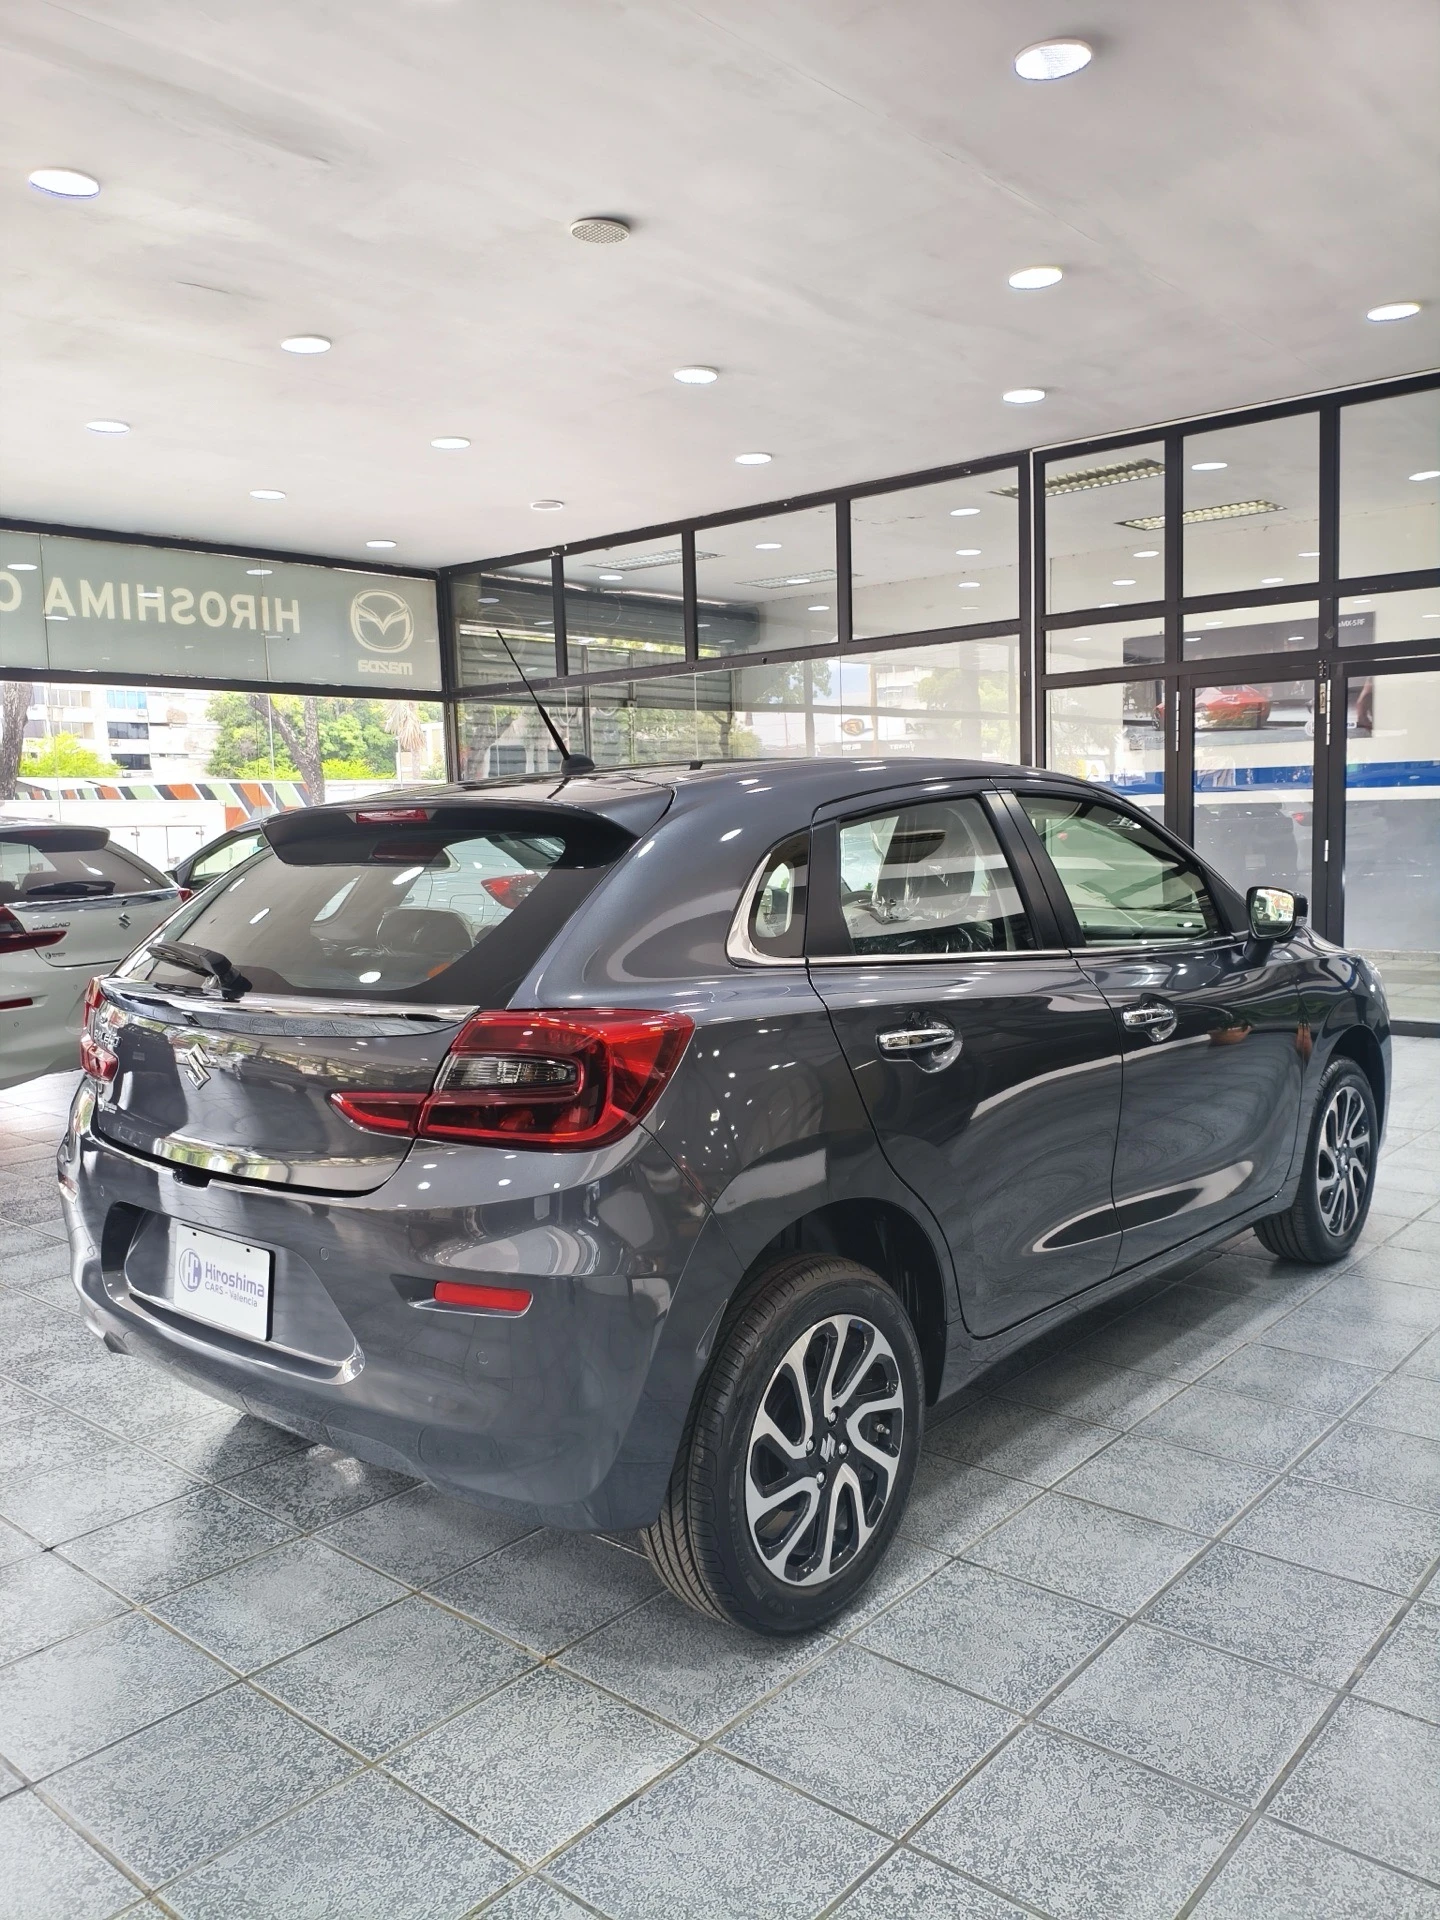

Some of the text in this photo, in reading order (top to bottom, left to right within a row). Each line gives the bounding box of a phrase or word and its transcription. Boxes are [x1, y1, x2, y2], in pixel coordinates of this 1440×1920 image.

[204, 1281, 224, 1295] CARS
[229, 1290, 258, 1307] Valencia
[205, 1261, 265, 1298] Hiroshima
